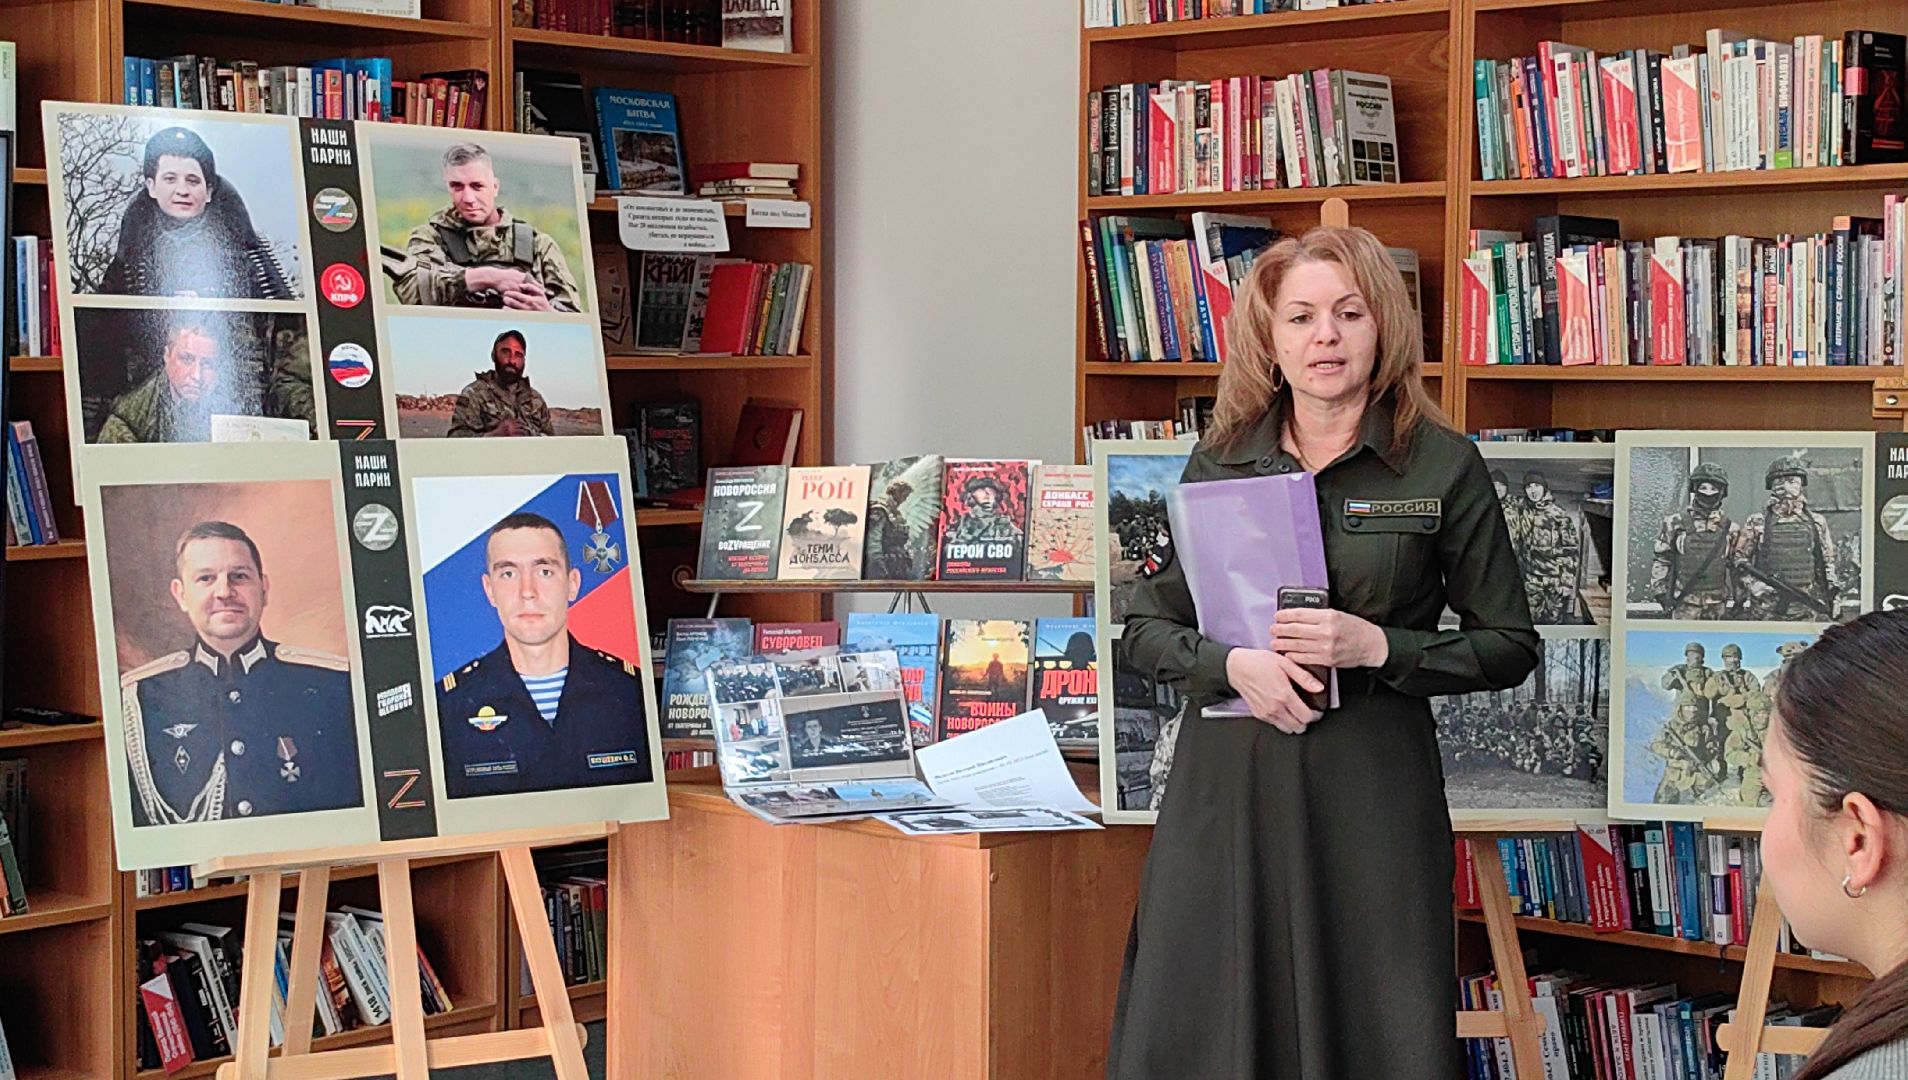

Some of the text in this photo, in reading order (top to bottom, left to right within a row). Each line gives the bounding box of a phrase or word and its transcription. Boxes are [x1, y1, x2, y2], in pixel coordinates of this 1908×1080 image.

[310, 127, 348, 146] НАШИ
[310, 147, 352, 165] ПАРНИ
[751, 209, 769, 217] Битва
[1543, 232, 1556, 280] ЭКОНОМИКА
[330, 293, 359, 302] КПРФ
[354, 455, 387, 470] НАШИ
[354, 472, 391, 487] ПАРНИ
[713, 483, 777, 497] НОВОРОССИЯ
[802, 476, 855, 500] РОЙ
[1044, 491, 1089, 500] ДОНБАСС
[1371, 502, 1436, 513] РОССИЯ
[807, 543, 834, 554] ТЕНИ
[947, 543, 1013, 559] ГЕРОИ СВО
[789, 553, 850, 565] ДОНБАССА
[762, 636, 823, 649] СУВОРОВЕЦ
[367, 995, 383, 1018] 1418
